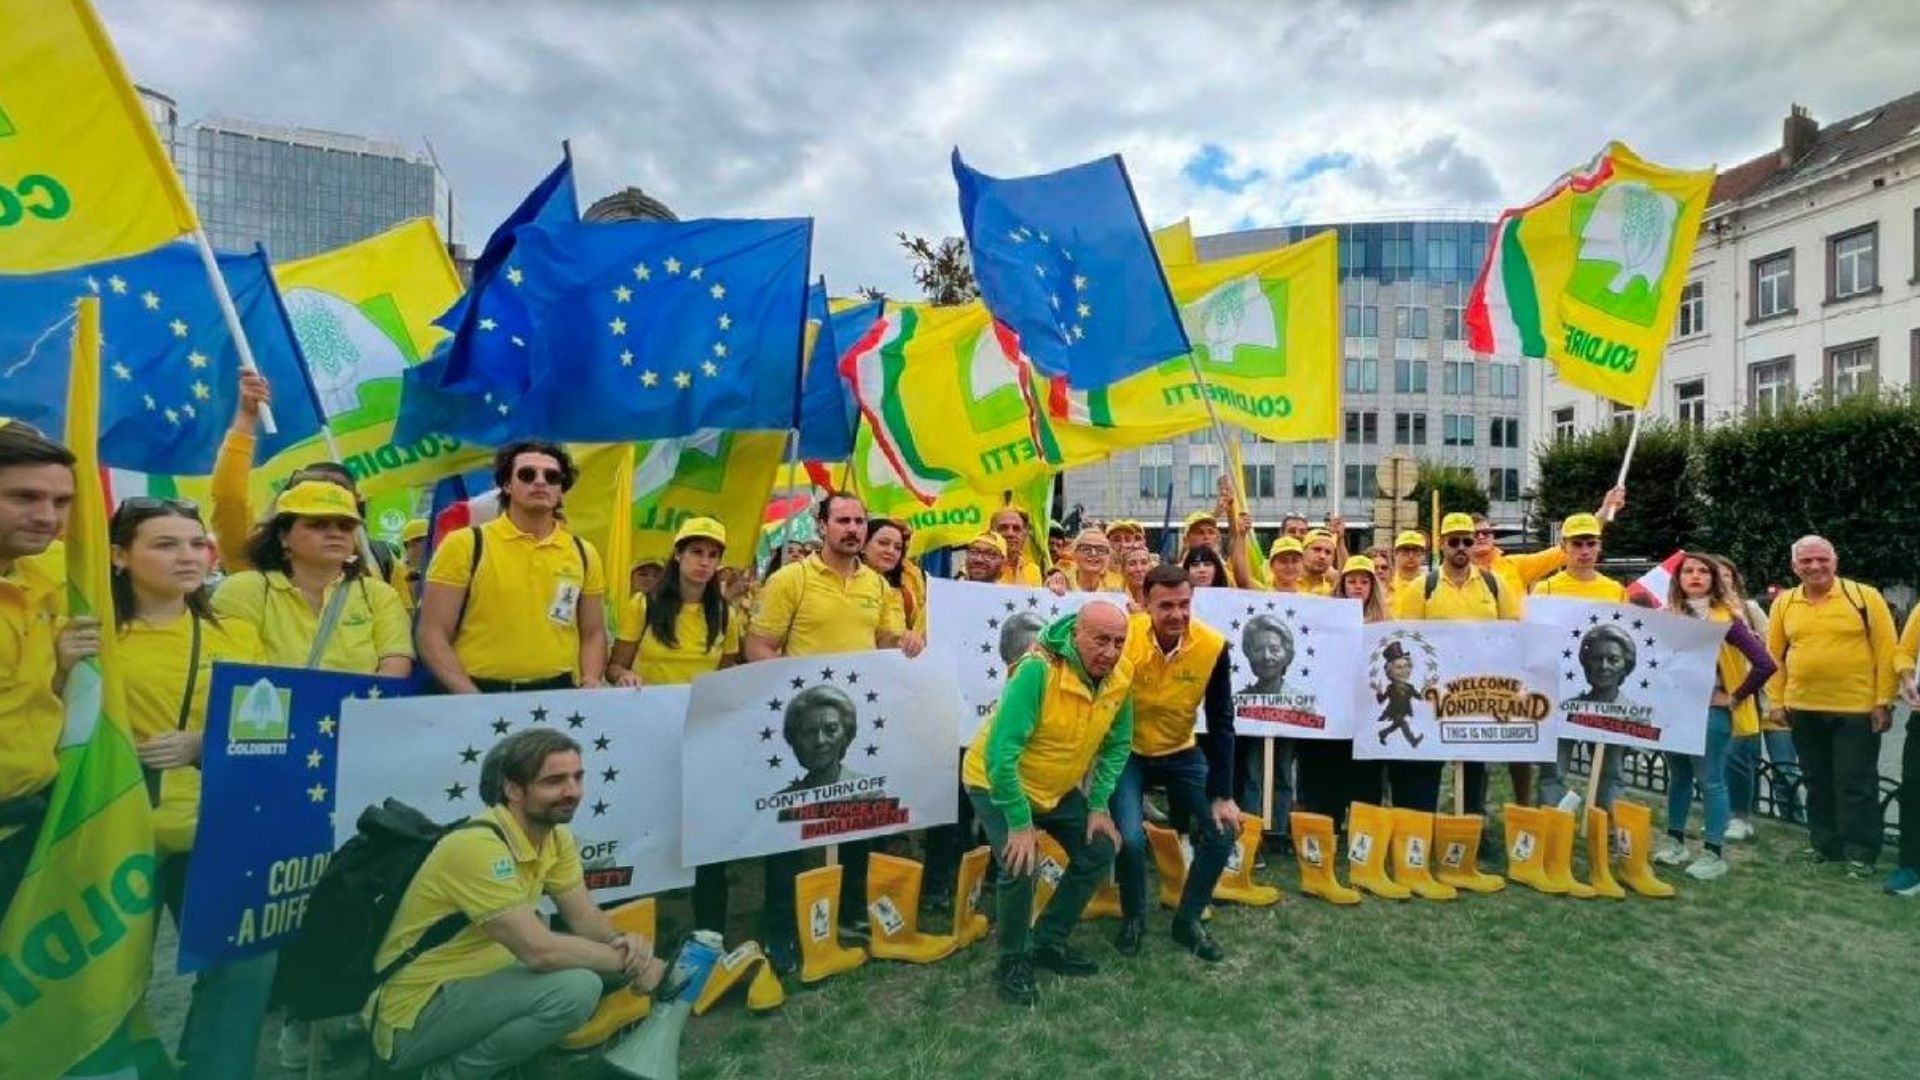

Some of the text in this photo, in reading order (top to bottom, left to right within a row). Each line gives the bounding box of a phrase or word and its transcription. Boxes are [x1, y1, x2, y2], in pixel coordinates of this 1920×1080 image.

[1446, 678, 1520, 694] WELCOME
[1260, 695, 1293, 706] TURN
[1295, 695, 1317, 706] OFF
[1595, 703, 1627, 715] TURN
[1629, 705, 1653, 717] OFF
[1446, 727, 1468, 739] THIS
[1469, 727, 1479, 739] IS
[1481, 727, 1499, 739] NOT
[755, 775, 887, 811] DON'T TURN OFF
[804, 808, 910, 838] PARLIAMENT
[580, 840, 619, 861] OFF
[236, 908, 255, 947] A
